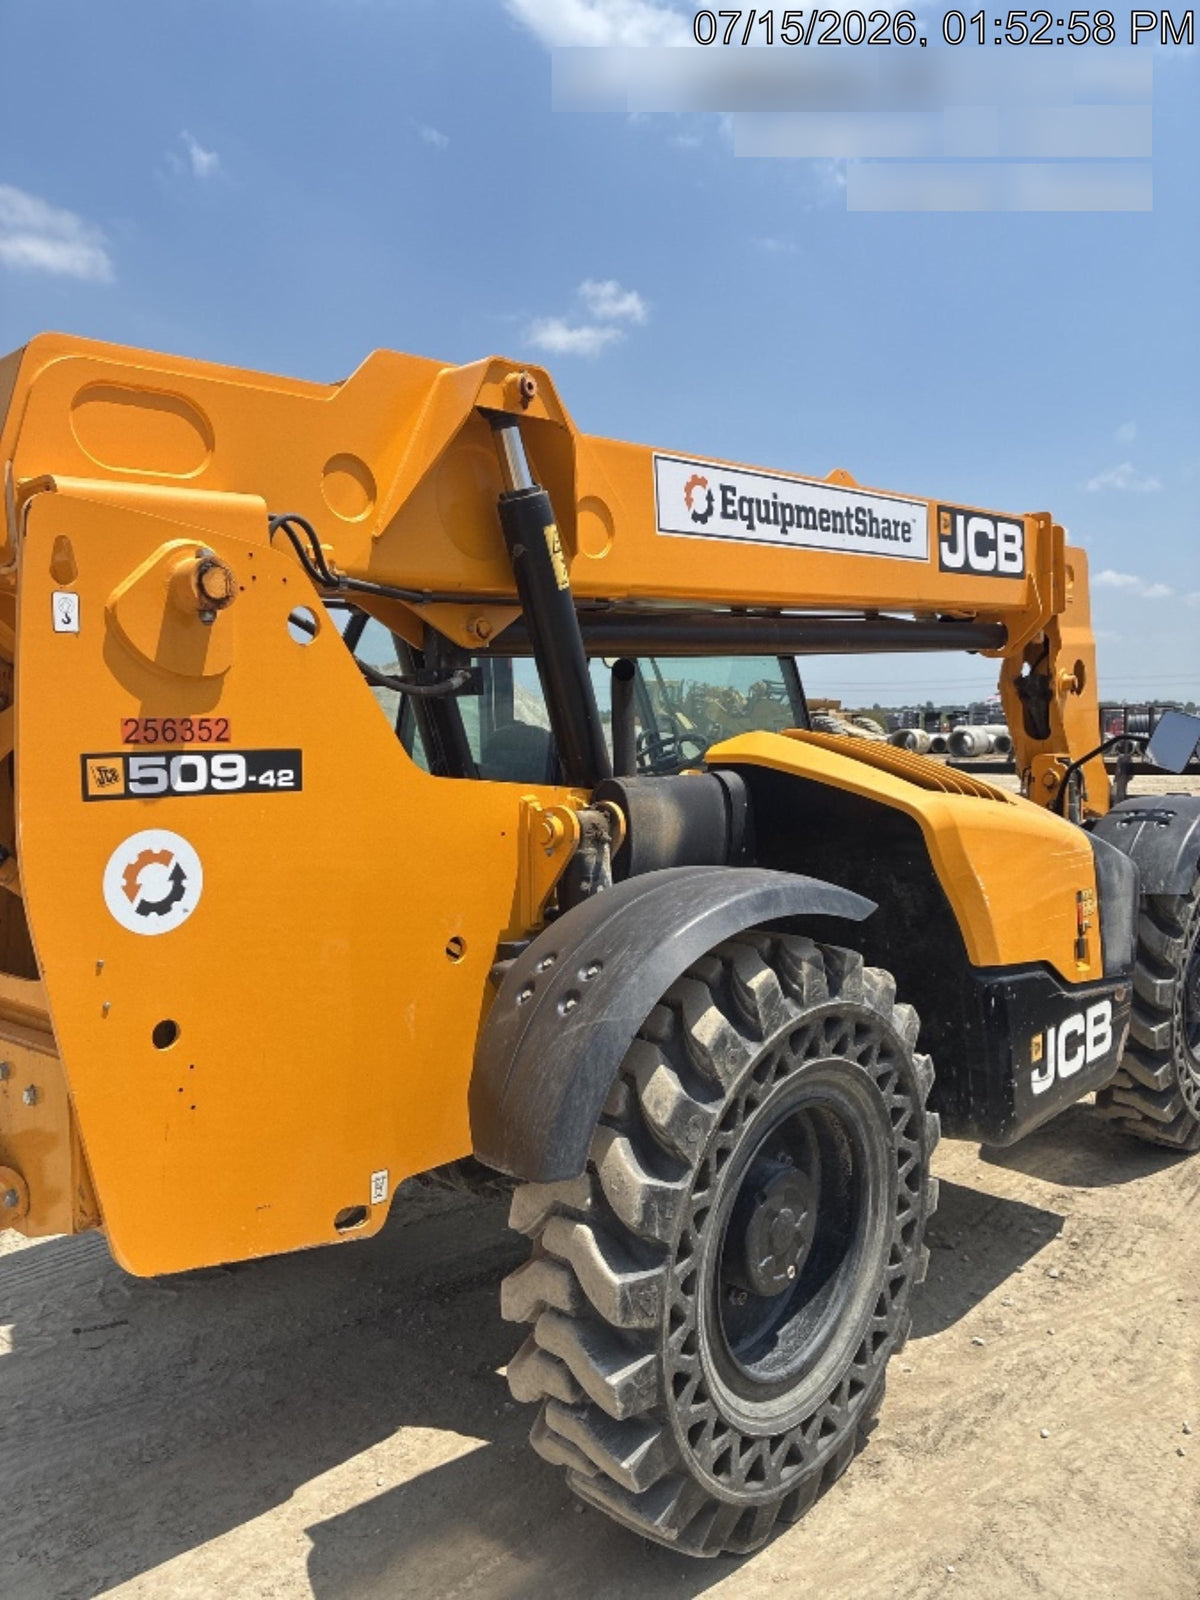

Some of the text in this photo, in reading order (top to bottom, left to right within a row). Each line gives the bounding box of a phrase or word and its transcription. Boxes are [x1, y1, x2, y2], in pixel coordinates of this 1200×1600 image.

[719, 483, 912, 543] EquipmentShare
[940, 514, 1023, 573] JCB
[123, 717, 230, 743] 256352
[128, 753, 295, 794] 509-42
[1030, 1000, 1112, 1095] JCB
